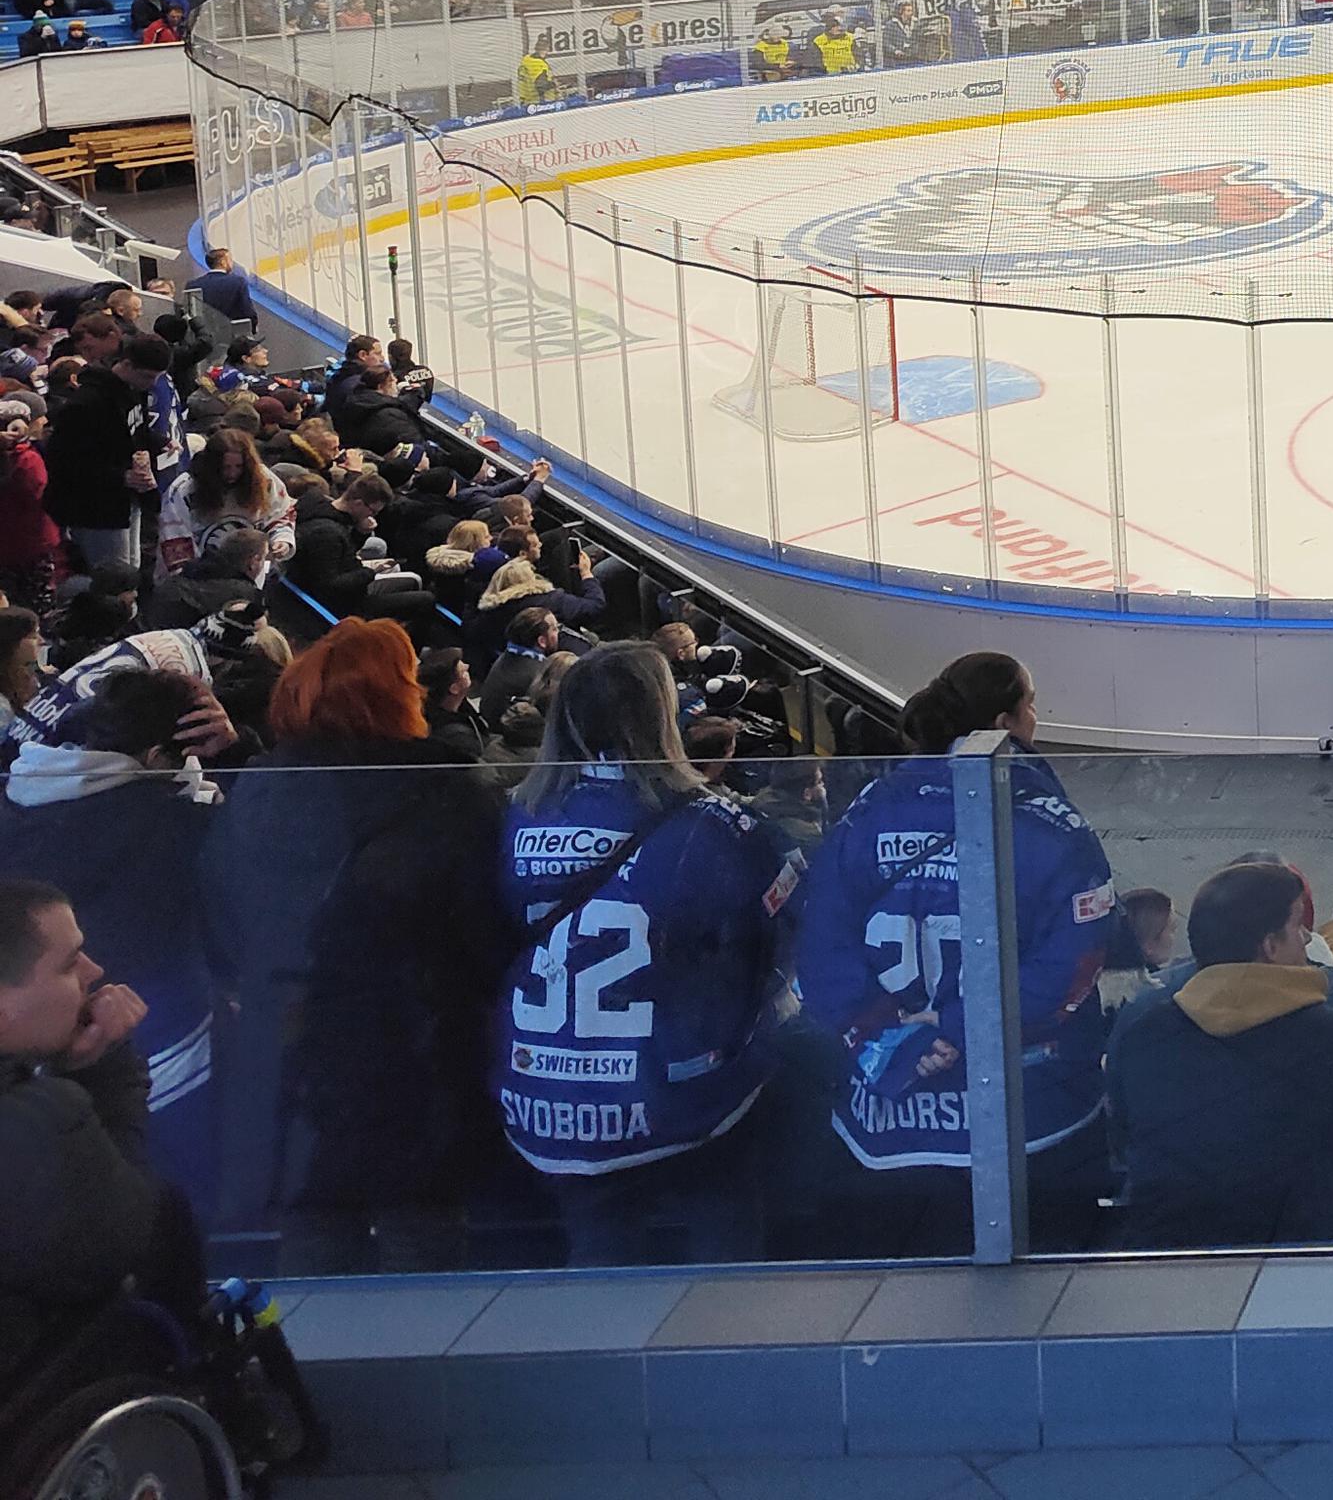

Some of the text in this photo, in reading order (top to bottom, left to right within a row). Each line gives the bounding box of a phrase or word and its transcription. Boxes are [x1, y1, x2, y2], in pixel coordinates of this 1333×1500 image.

[512, 899, 653, 1037] 32
[536, 1053, 633, 1076] SWIETELSKY
[501, 1088, 651, 1142] SVOBODA
